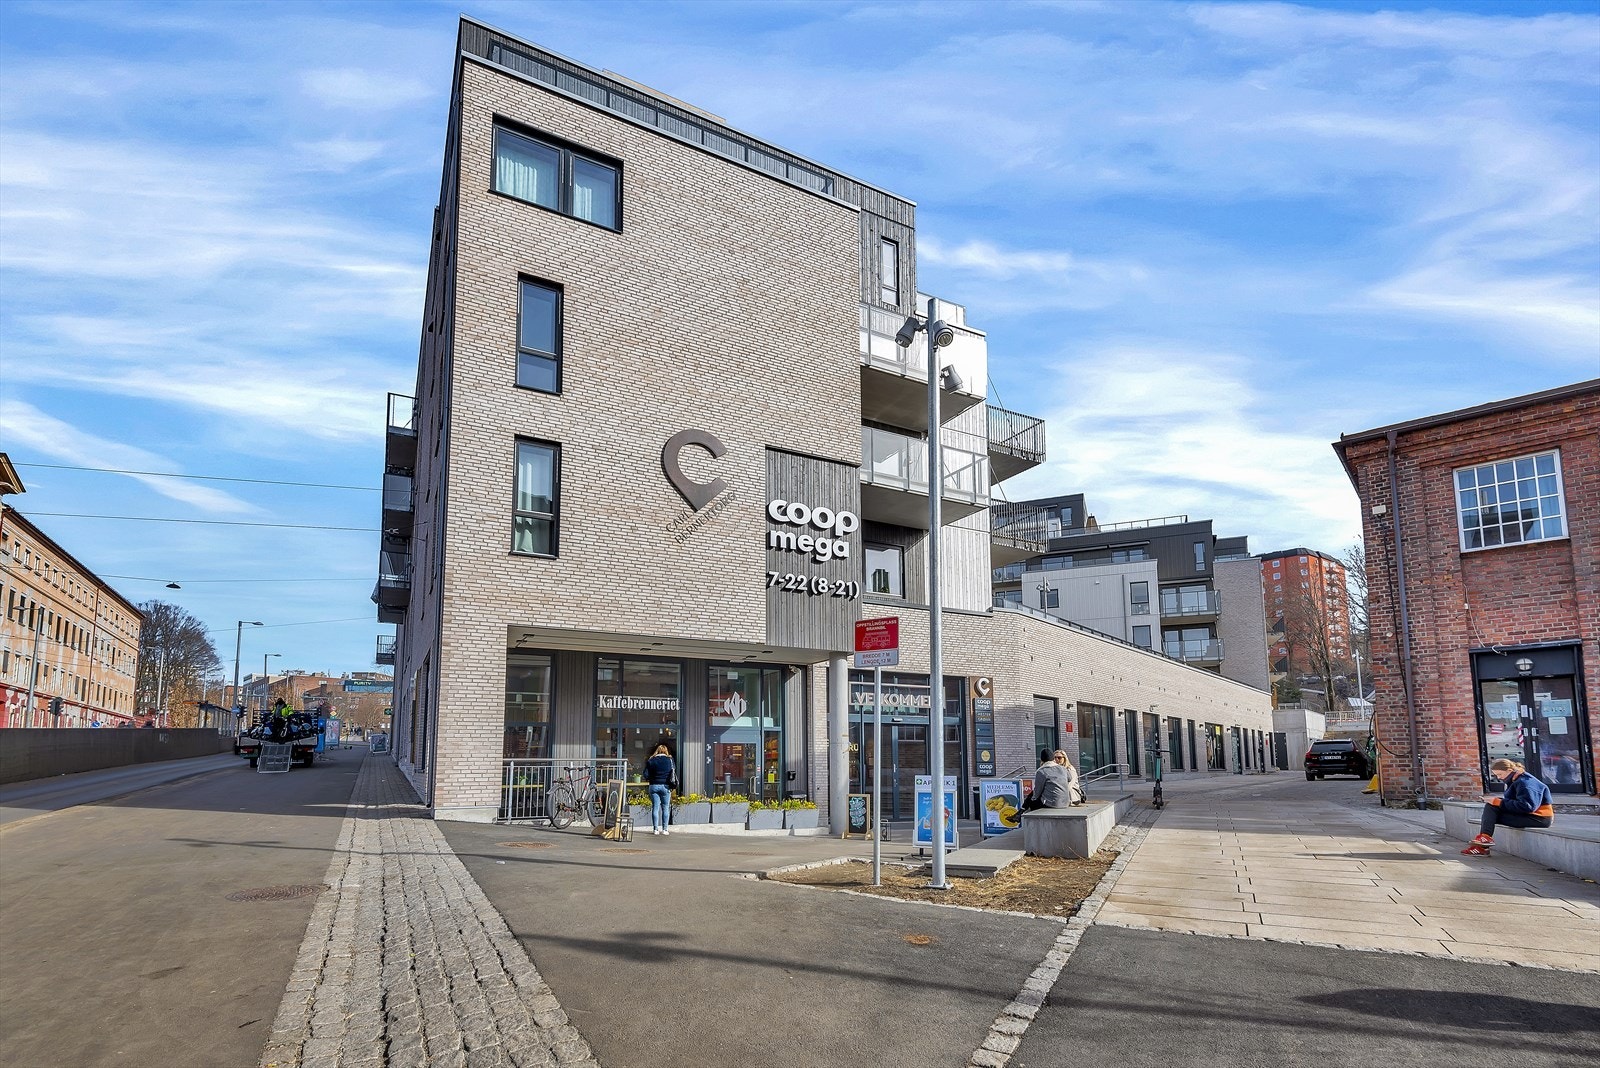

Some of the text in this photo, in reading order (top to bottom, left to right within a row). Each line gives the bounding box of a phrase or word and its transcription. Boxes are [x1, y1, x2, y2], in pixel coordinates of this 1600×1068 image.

[666, 510, 692, 532] CARL
[768, 500, 859, 537] coop
[770, 530, 850, 561] mega
[768, 571, 860, 599] 7-22 (8-21)
[599, 695, 680, 711] Kaffebrenneriet
[855, 692, 932, 708] VEKOMME
